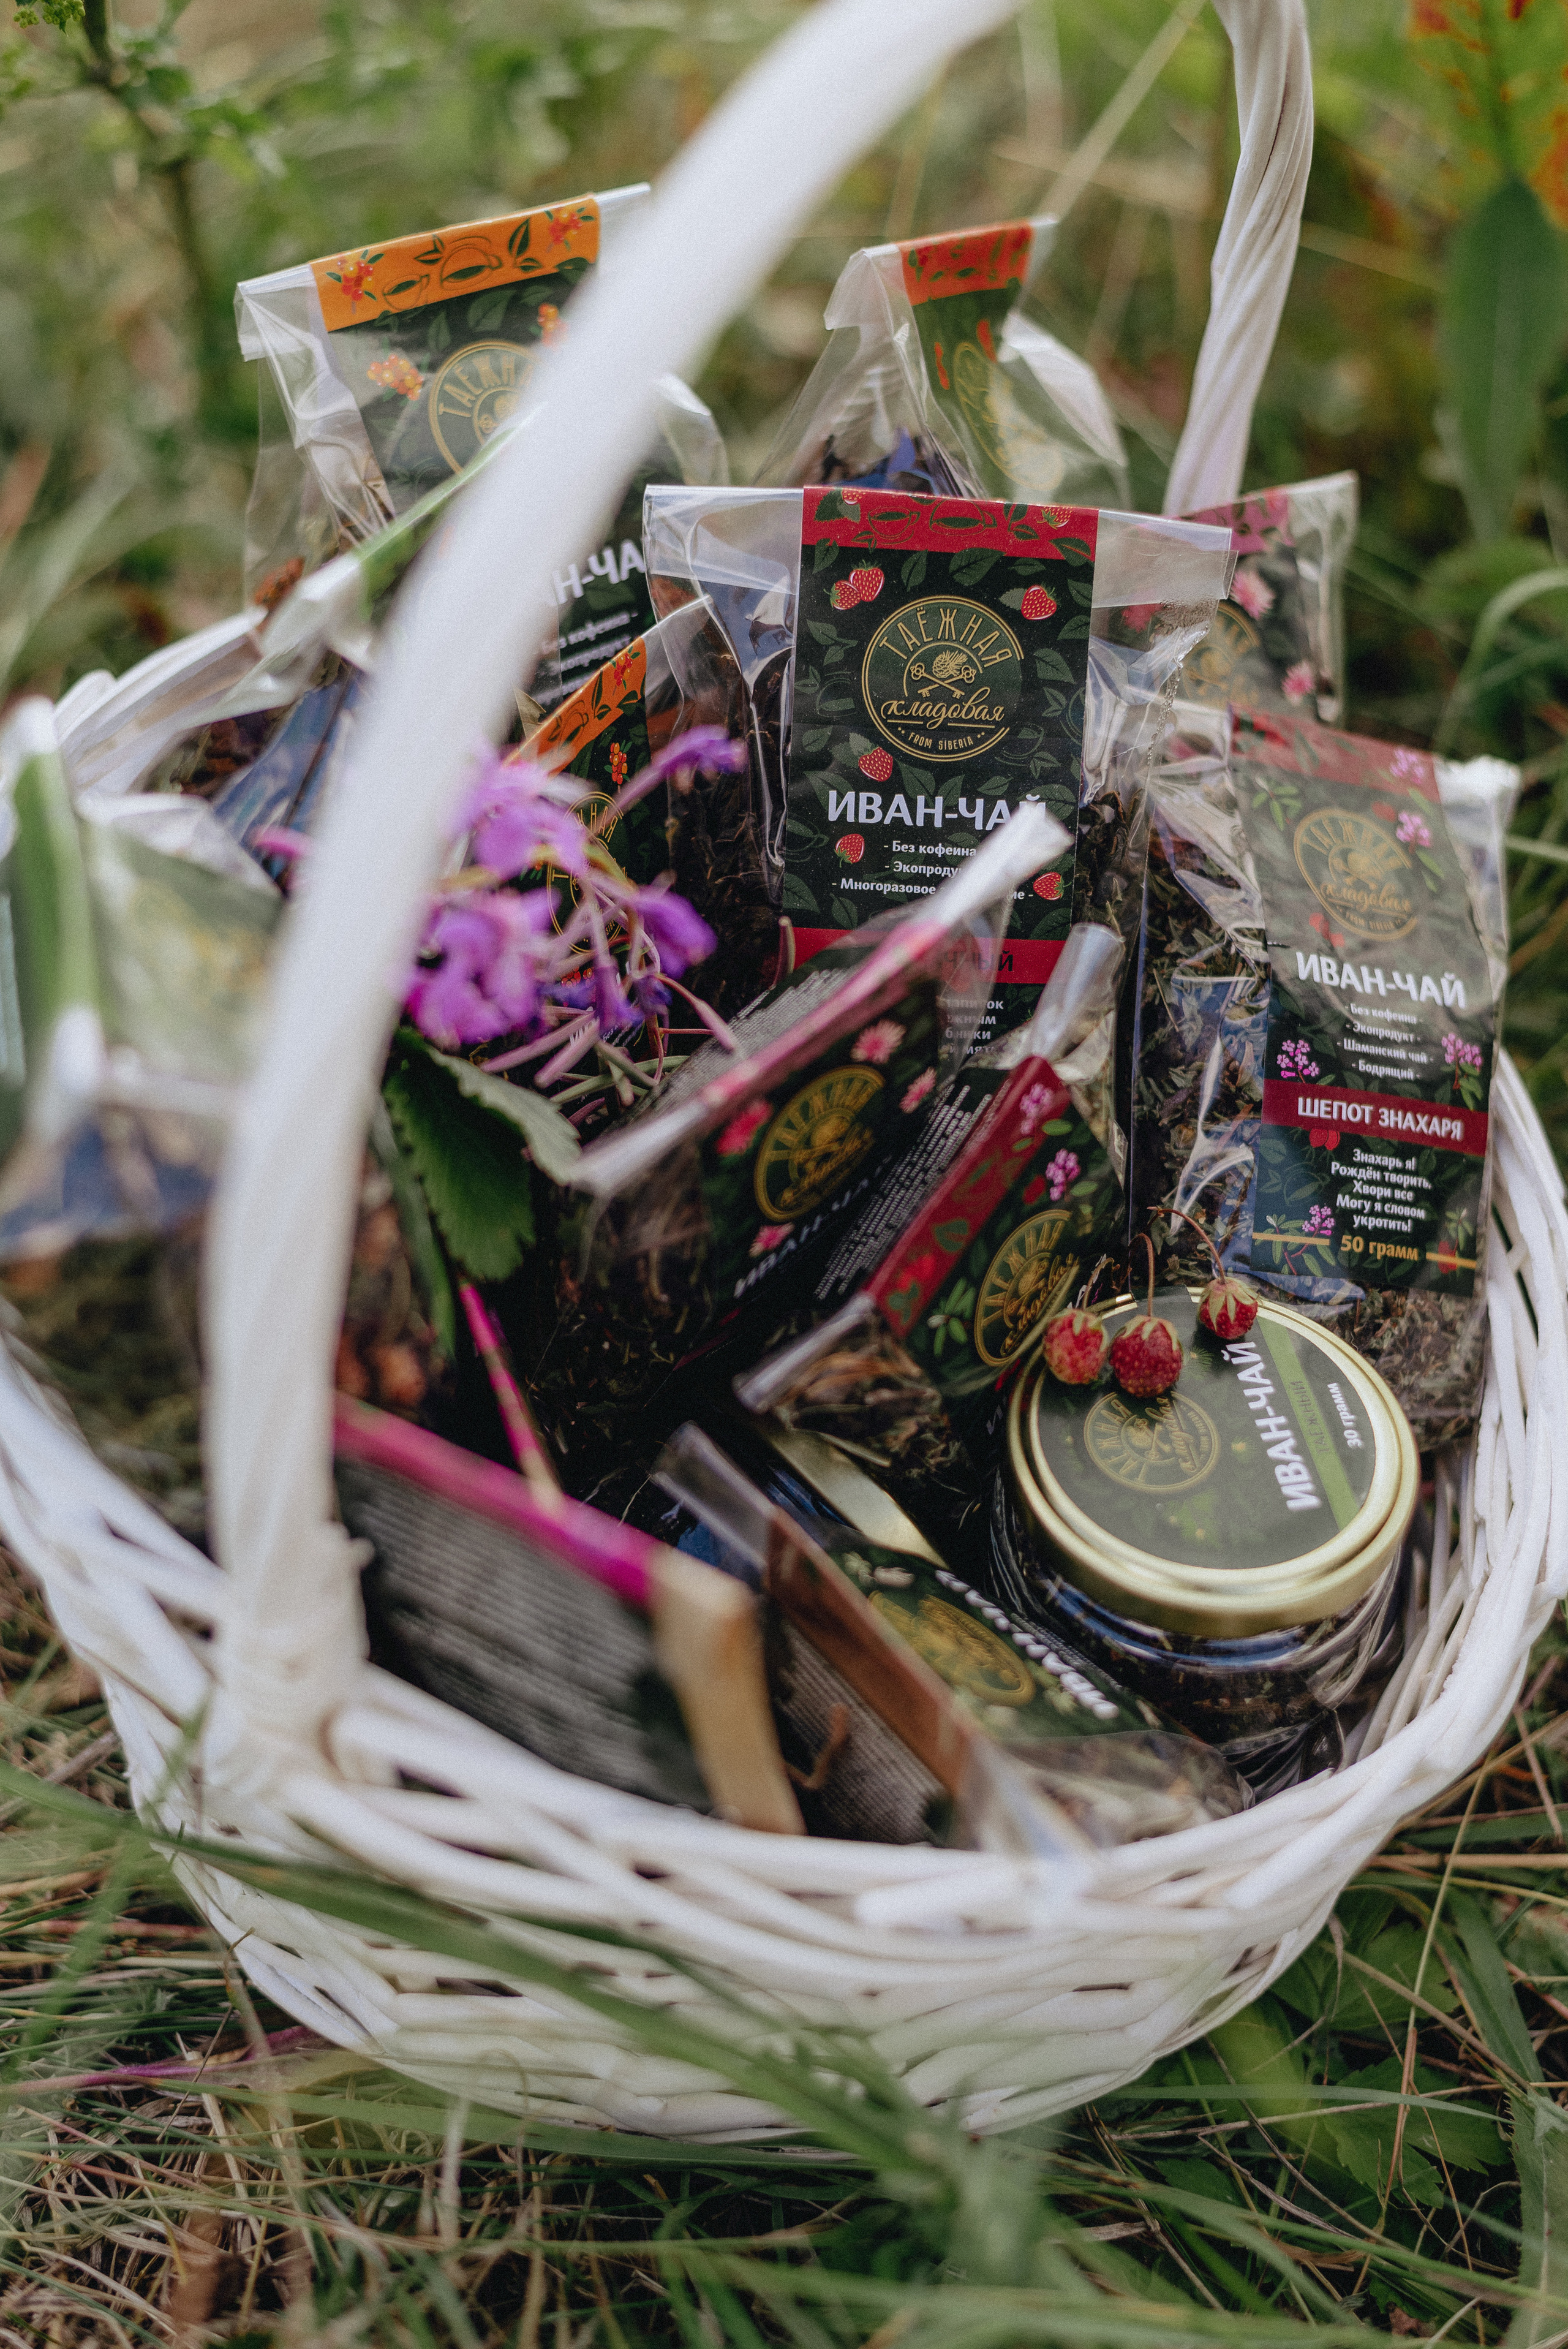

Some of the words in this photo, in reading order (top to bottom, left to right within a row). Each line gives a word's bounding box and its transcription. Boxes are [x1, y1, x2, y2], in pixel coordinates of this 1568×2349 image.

[879, 607, 1012, 668] ТАЁЖНАЯ
[881, 686, 1005, 730] кладовая
[908, 732, 932, 749] FROM
[938, 736, 974, 751] SIBERIA
[892, 841, 915, 853] Без
[919, 844, 977, 858] кофеина
[893, 861, 963, 879] Экопроду
[840, 878, 937, 895] Многоразовое
[1296, 951, 1466, 1010] ИВАН-ЧАЙ
[1350, 1003, 1370, 1017] Без
[1371, 1008, 1417, 1024] кофеина
[1352, 1021, 1415, 1043] Экопродукт
[1343, 1038, 1406, 1061] Шаманский
[1408, 1051, 1429, 1064] чай
[1359, 1059, 1414, 1081] Бодрящий
[1298, 1096, 1374, 1125] ШЕПОТ
[1378, 1107, 1464, 1141] ЗНАХАРЯ
[1352, 1148, 1403, 1170] Знахарь
[1405, 1156, 1416, 1171] я!
[1331, 1162, 1380, 1181] Рождён
[1352, 1180, 1393, 1200] Хвори
[1394, 1190, 1414, 1201] все
[1336, 1194, 1371, 1213] Могу
[1374, 1202, 1381, 1211] я
[1384, 1203, 1425, 1220] словом
[1352, 1214, 1412, 1233] укротить!
[1341, 1235, 1364, 1253] 50
[1369, 1241, 1419, 1261] грамм
[1327, 1382, 1356, 1428] грамм
[1221, 1341, 1322, 1511] ИВАН-ЧАЙ
[1343, 1429, 1363, 1449] 30
